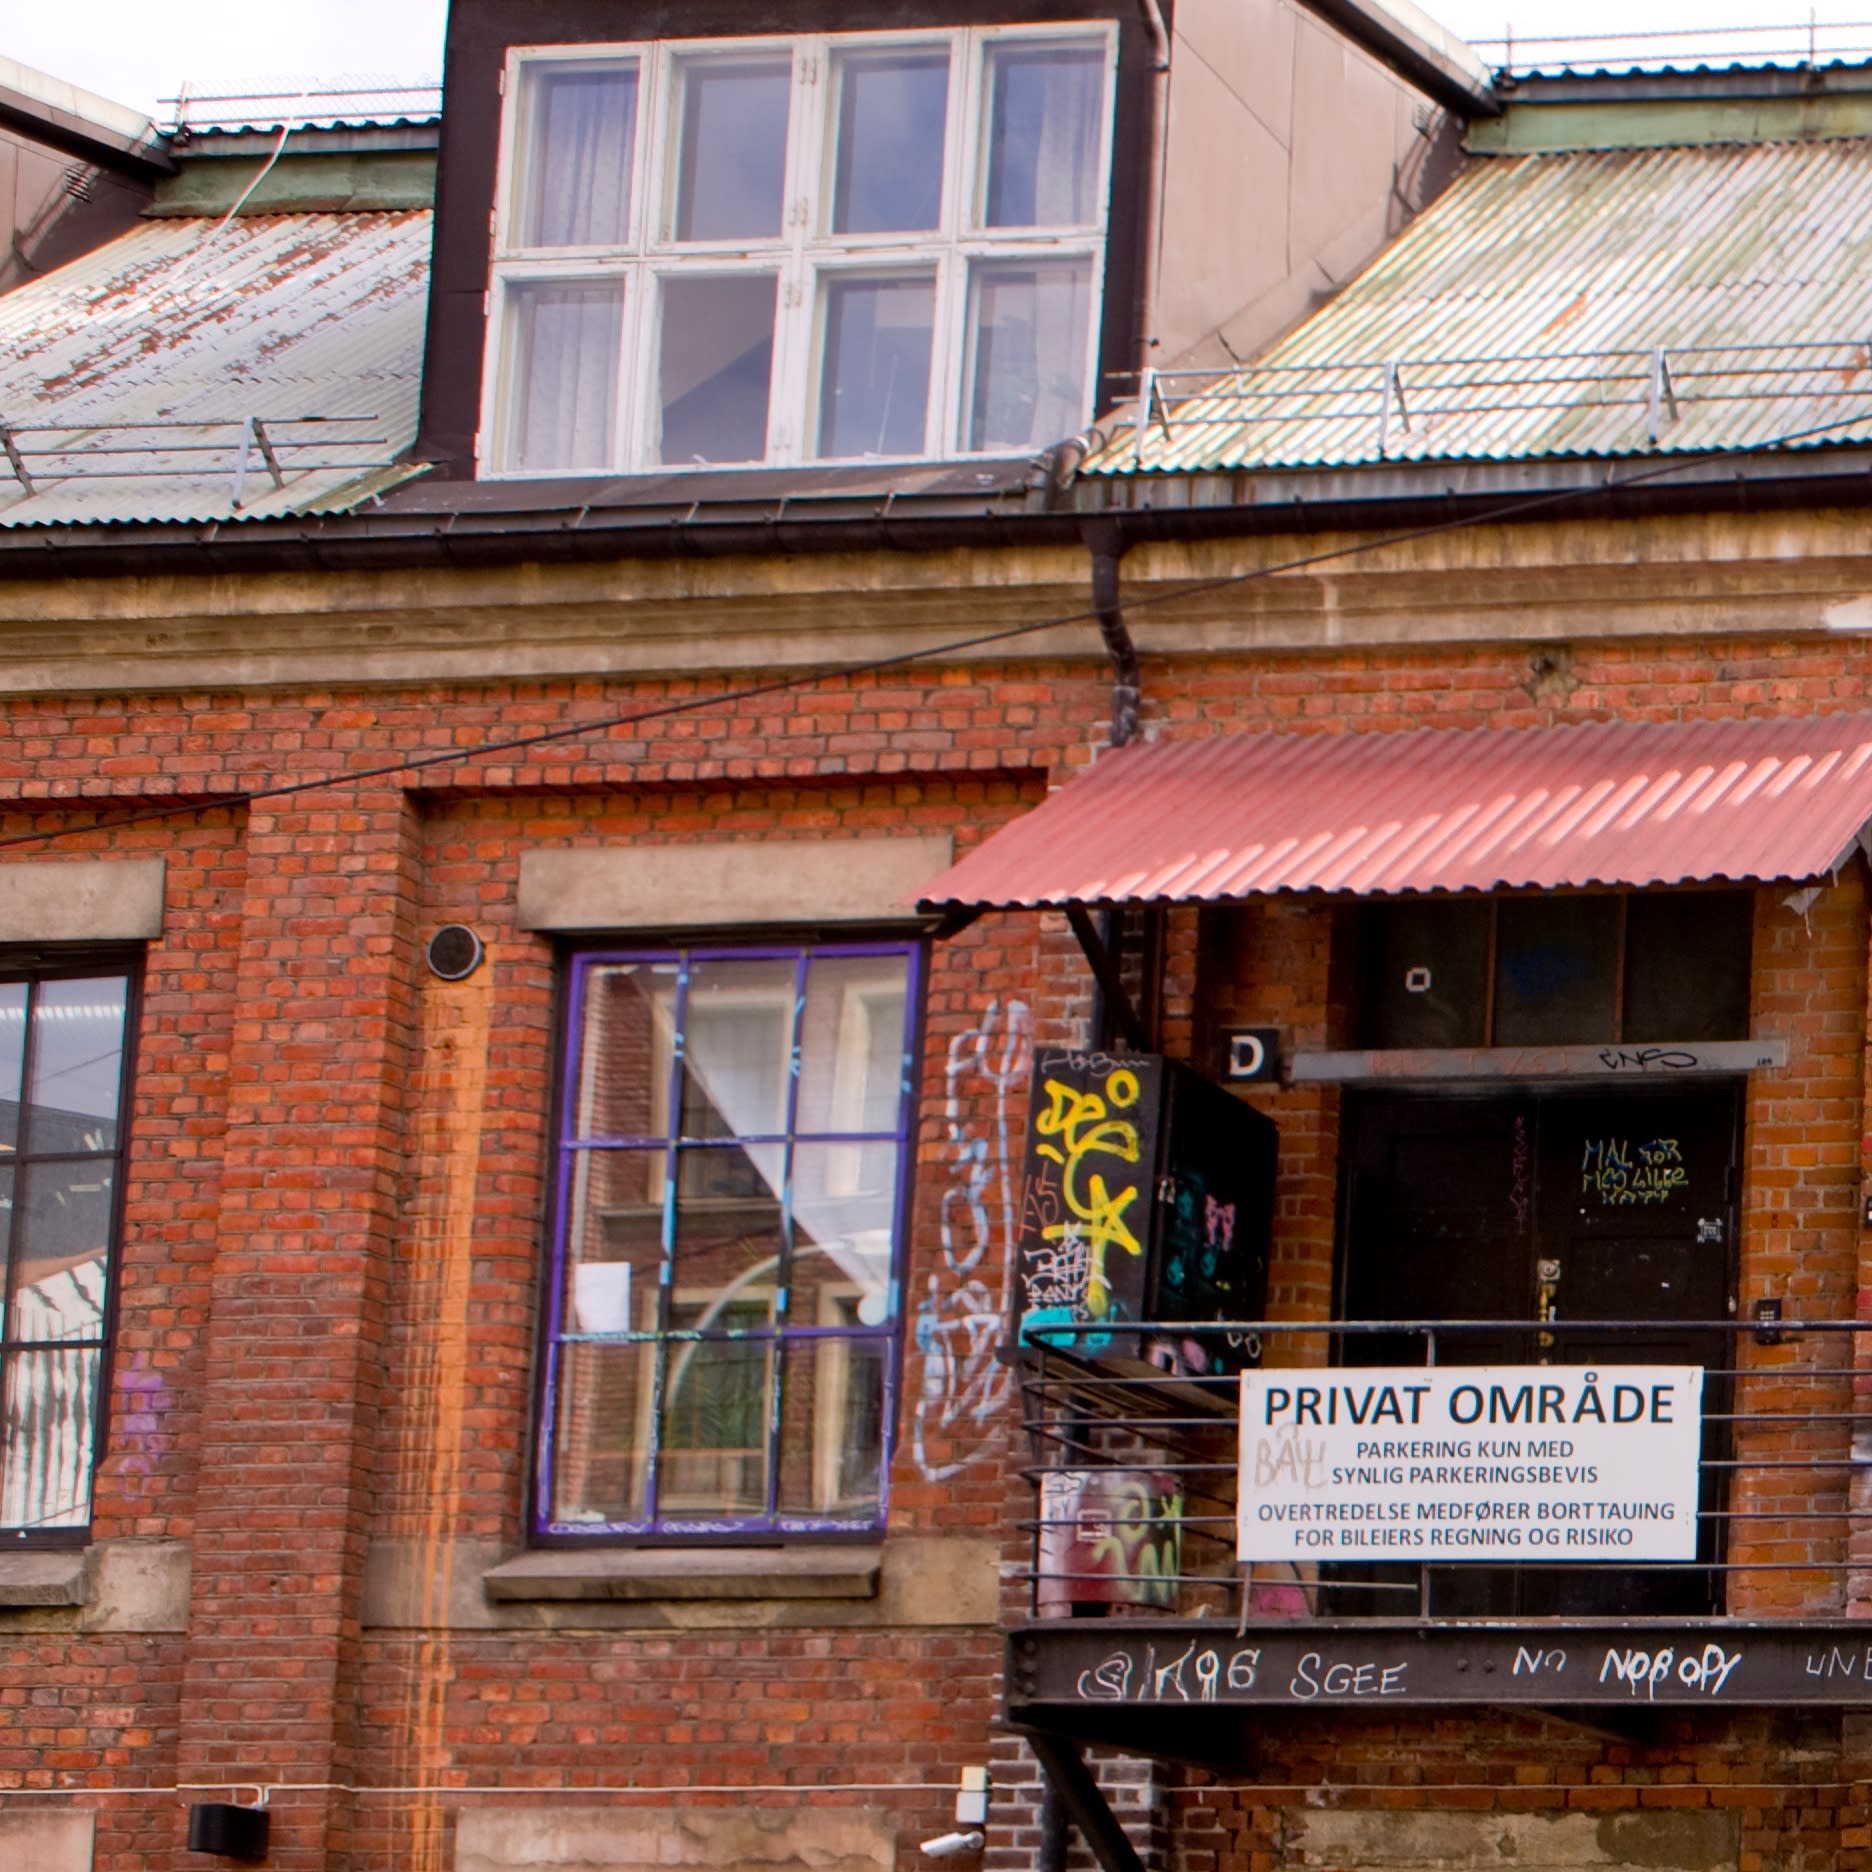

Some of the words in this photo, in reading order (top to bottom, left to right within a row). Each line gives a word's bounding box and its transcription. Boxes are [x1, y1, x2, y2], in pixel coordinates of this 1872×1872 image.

[1229, 1035, 1265, 1077] D
[1265, 1385, 1431, 1425] PRIVAT
[1448, 1371, 1675, 1425] OMRÅDE
[1356, 1440, 1472, 1459] PARKERING
[1478, 1440, 1523, 1459] KUN
[1527, 1440, 1574, 1459] MED
[1332, 1467, 1404, 1485] SYNLIG
[1409, 1466, 1599, 1485] PARKERINGSBEVIS
[1258, 1502, 1411, 1522] OVERTREDELSE
[1416, 1502, 1533, 1522] MEDFØRER
[1295, 1529, 1335, 1547] FOR
[1340, 1528, 1425, 1547] BILEIERS
[1430, 1528, 1522, 1547] REGNING
[1528, 1528, 1560, 1546] OG
[1566, 1528, 1633, 1546] RISIKO
